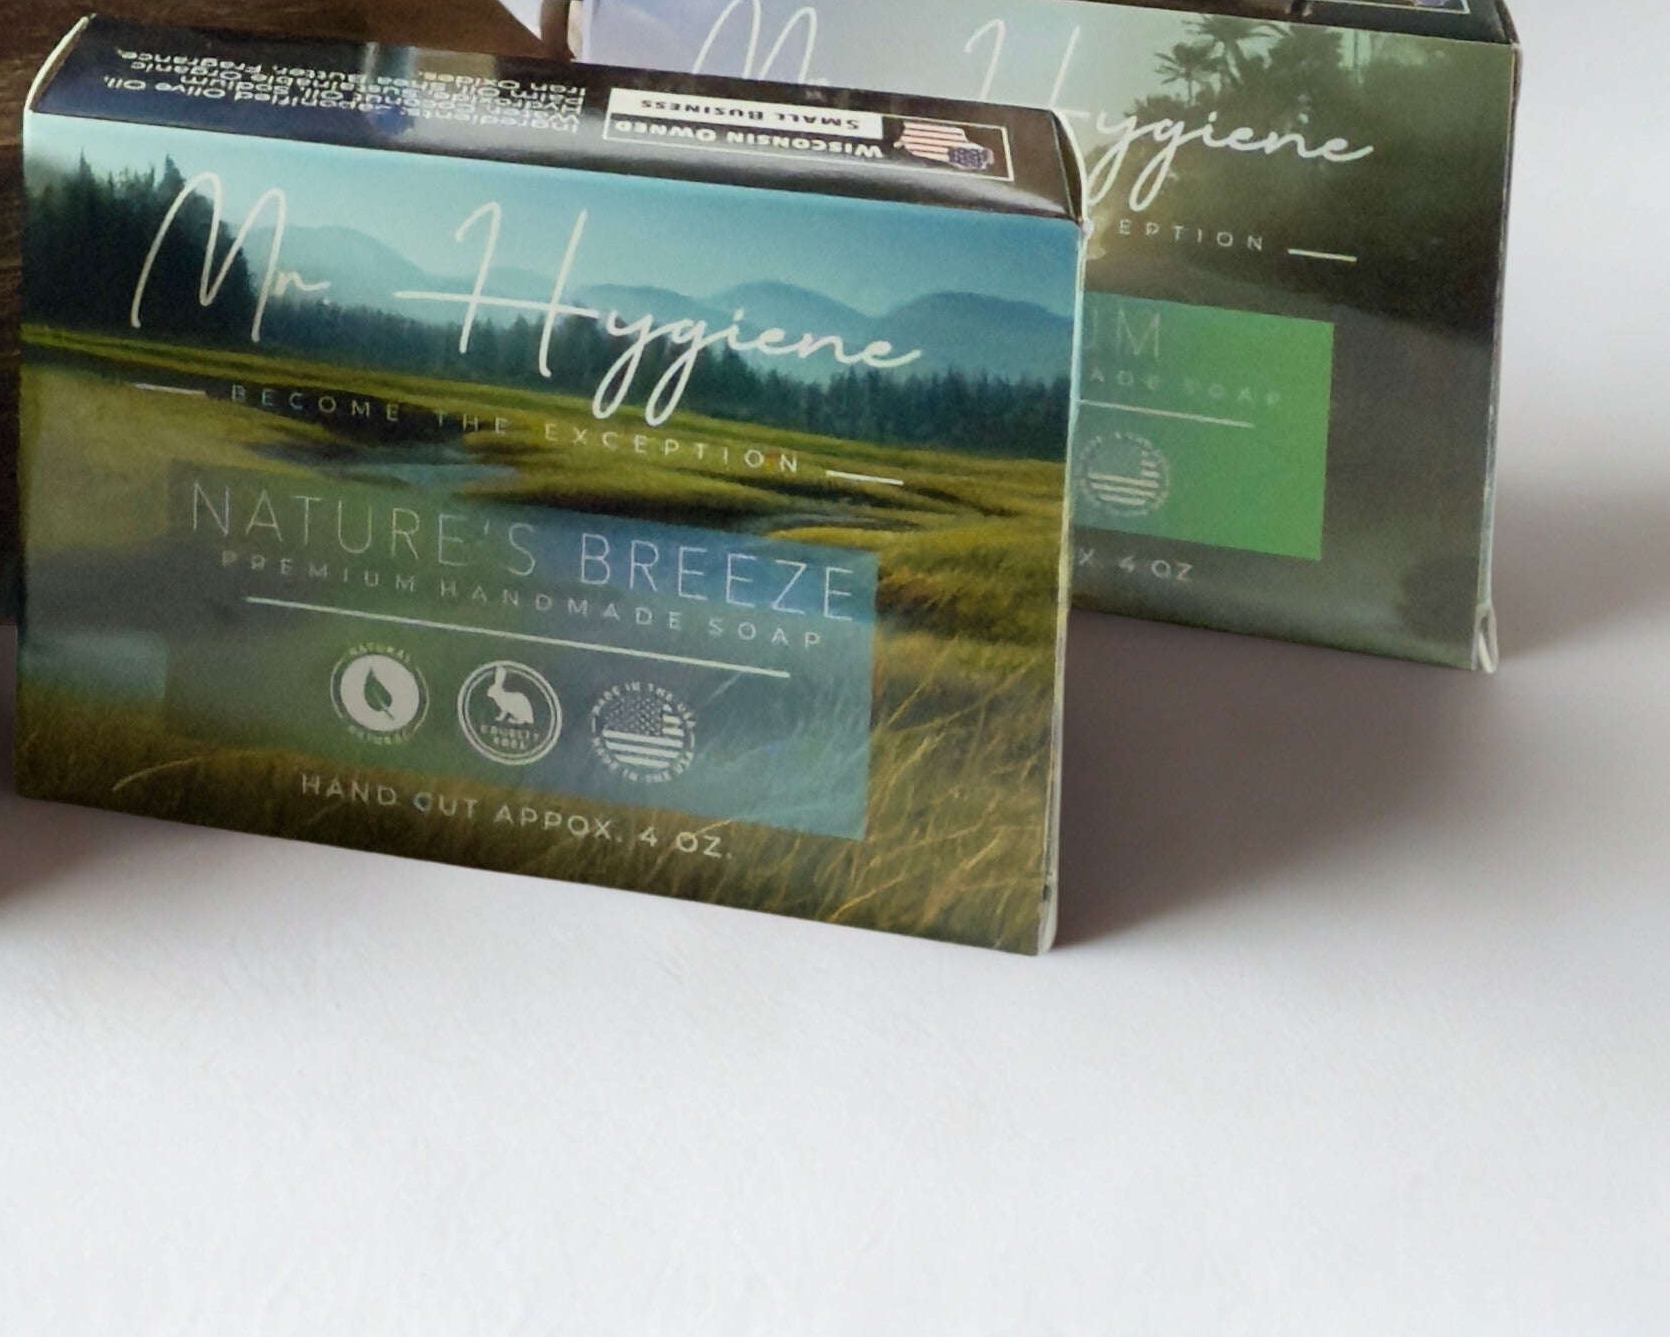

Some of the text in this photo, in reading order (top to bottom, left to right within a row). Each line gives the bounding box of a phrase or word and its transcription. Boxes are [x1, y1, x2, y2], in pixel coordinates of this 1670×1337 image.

[105, 76, 146, 90] Oil,
[155, 82, 226, 98] Olive
[530, 83, 586, 97] Iron
[641, 100, 859, 130] SMALL BUSINESS
[615, 121, 883, 158] WISCONSIN OWNED
[1118, 218, 1264, 253] EPTION
[130, 171, 920, 426] Mr. Hygiene
[229, 384, 798, 473] BECOME THE EXCEPTION
[191, 481, 853, 622] NATURE'S BREEZE
[221, 550, 820, 648] PREMIUM HANDMADE SOAP
[301, 773, 398, 806] HAND
[493, 805, 622, 843] APPOX.
[639, 826, 657, 848] 4
[675, 832, 732, 859] OZ.
